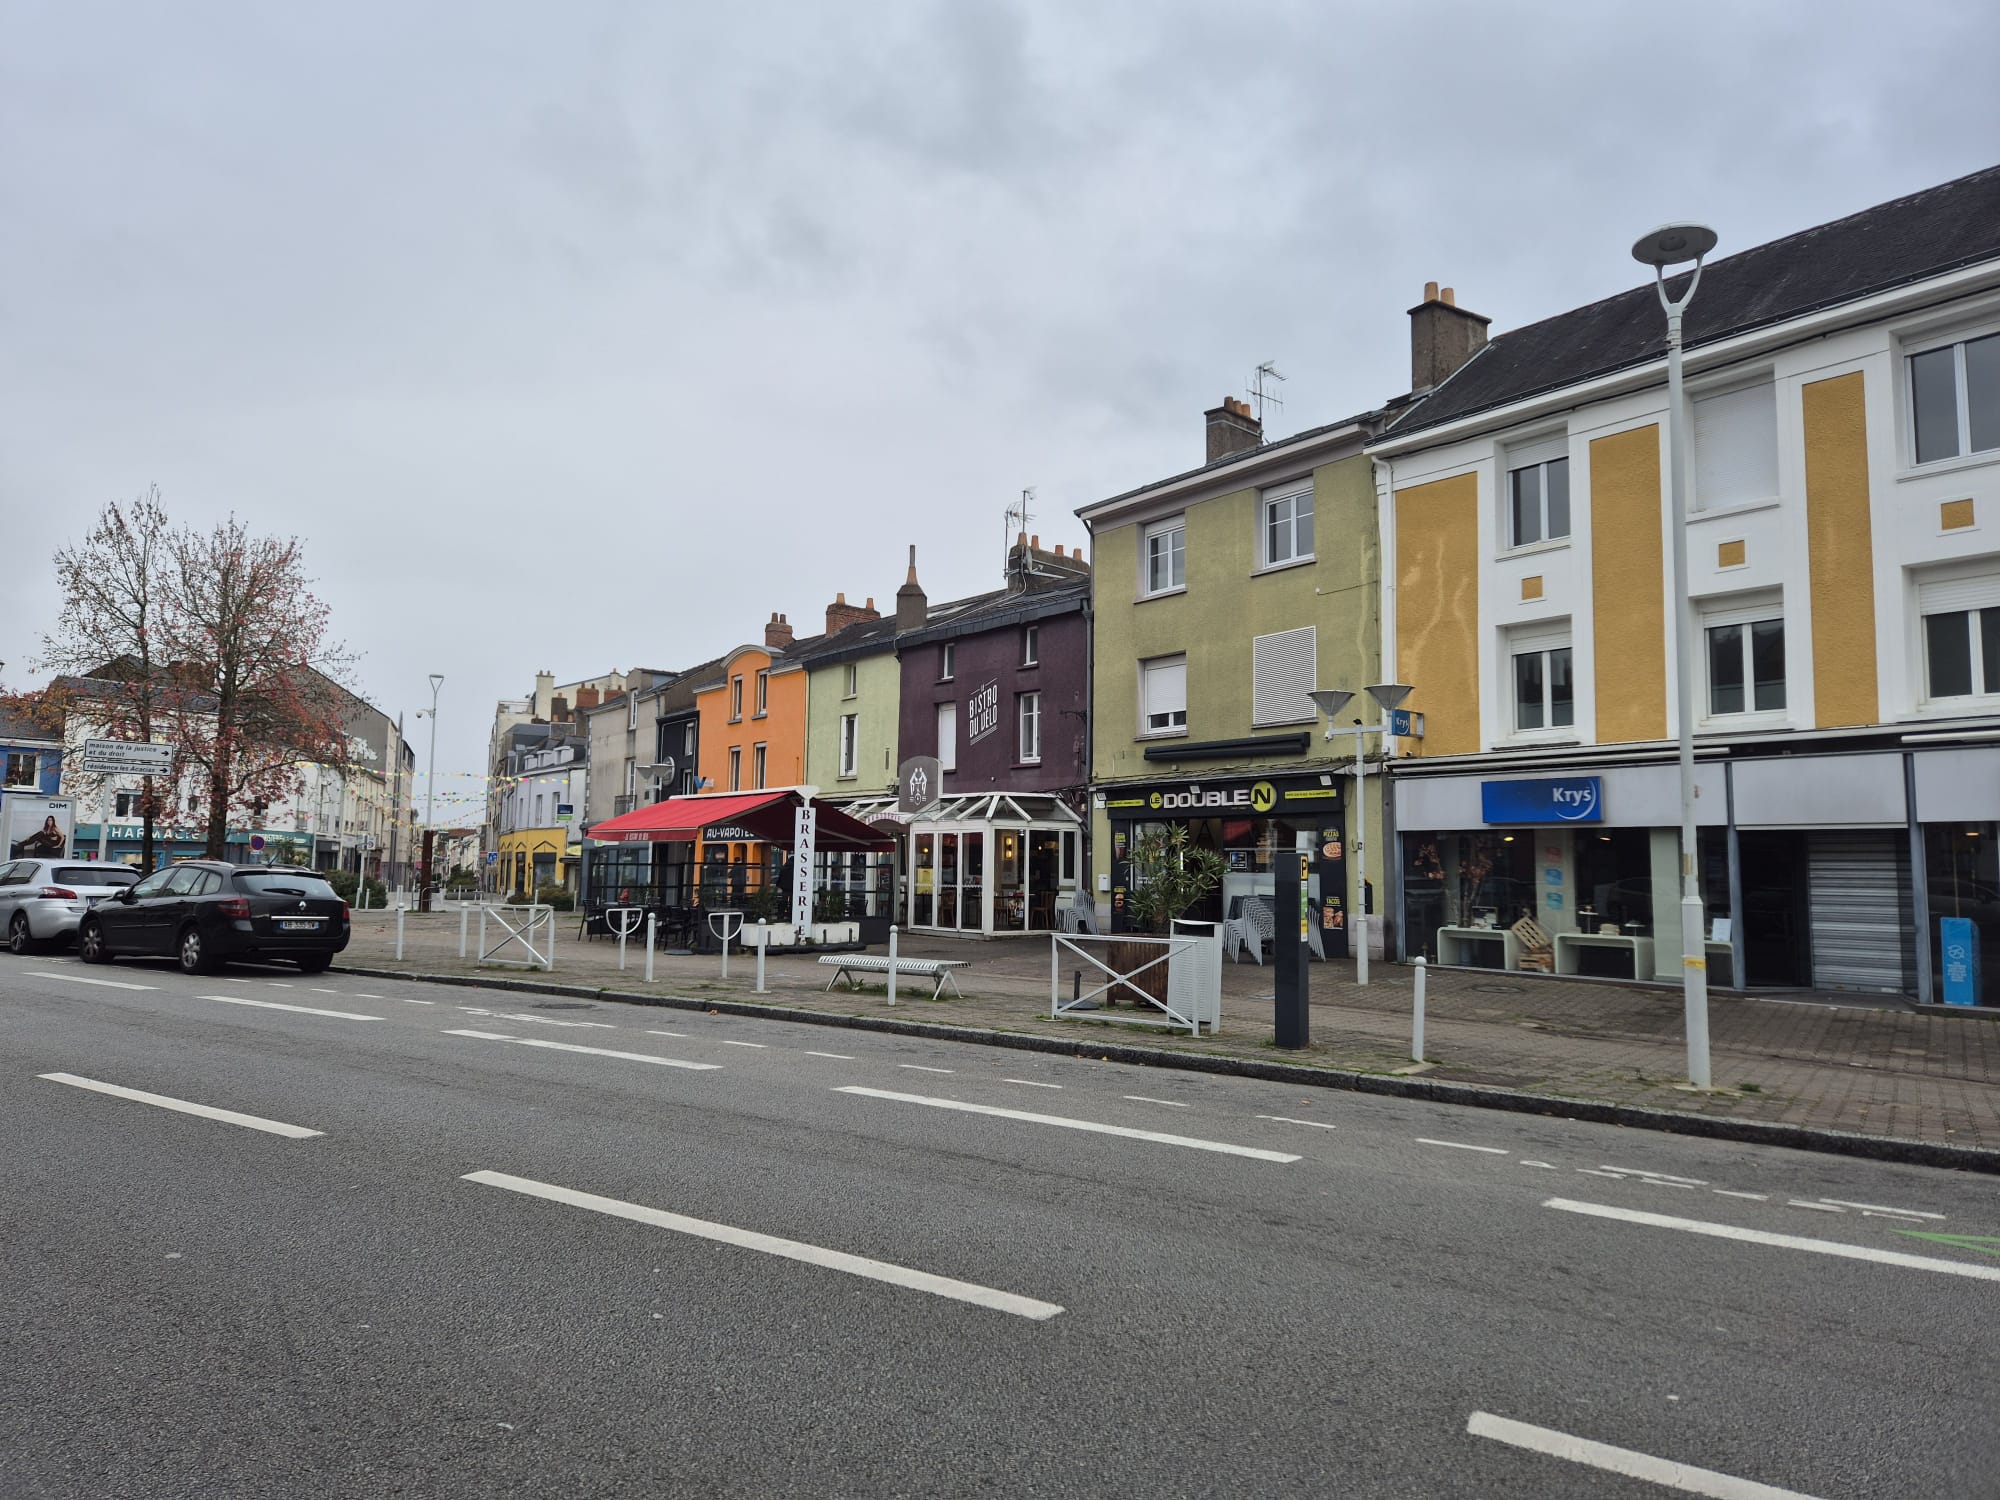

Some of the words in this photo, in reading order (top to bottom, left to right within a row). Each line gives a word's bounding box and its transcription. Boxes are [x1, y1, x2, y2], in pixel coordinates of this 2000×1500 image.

[969, 684, 997, 719] BISTRO
[969, 716, 978, 738] DU
[133, 745, 157, 753] justice
[87, 763, 118, 771] résidence
[130, 765, 156, 773] Acacias
[1150, 796, 1161, 804] LE
[1163, 789, 1251, 809] DOUBLE
[1252, 787, 1271, 805] N
[1552, 787, 1592, 807] Krys
[798, 809, 811, 936] BRASSERIE
[1301, 858, 1307, 878] P
